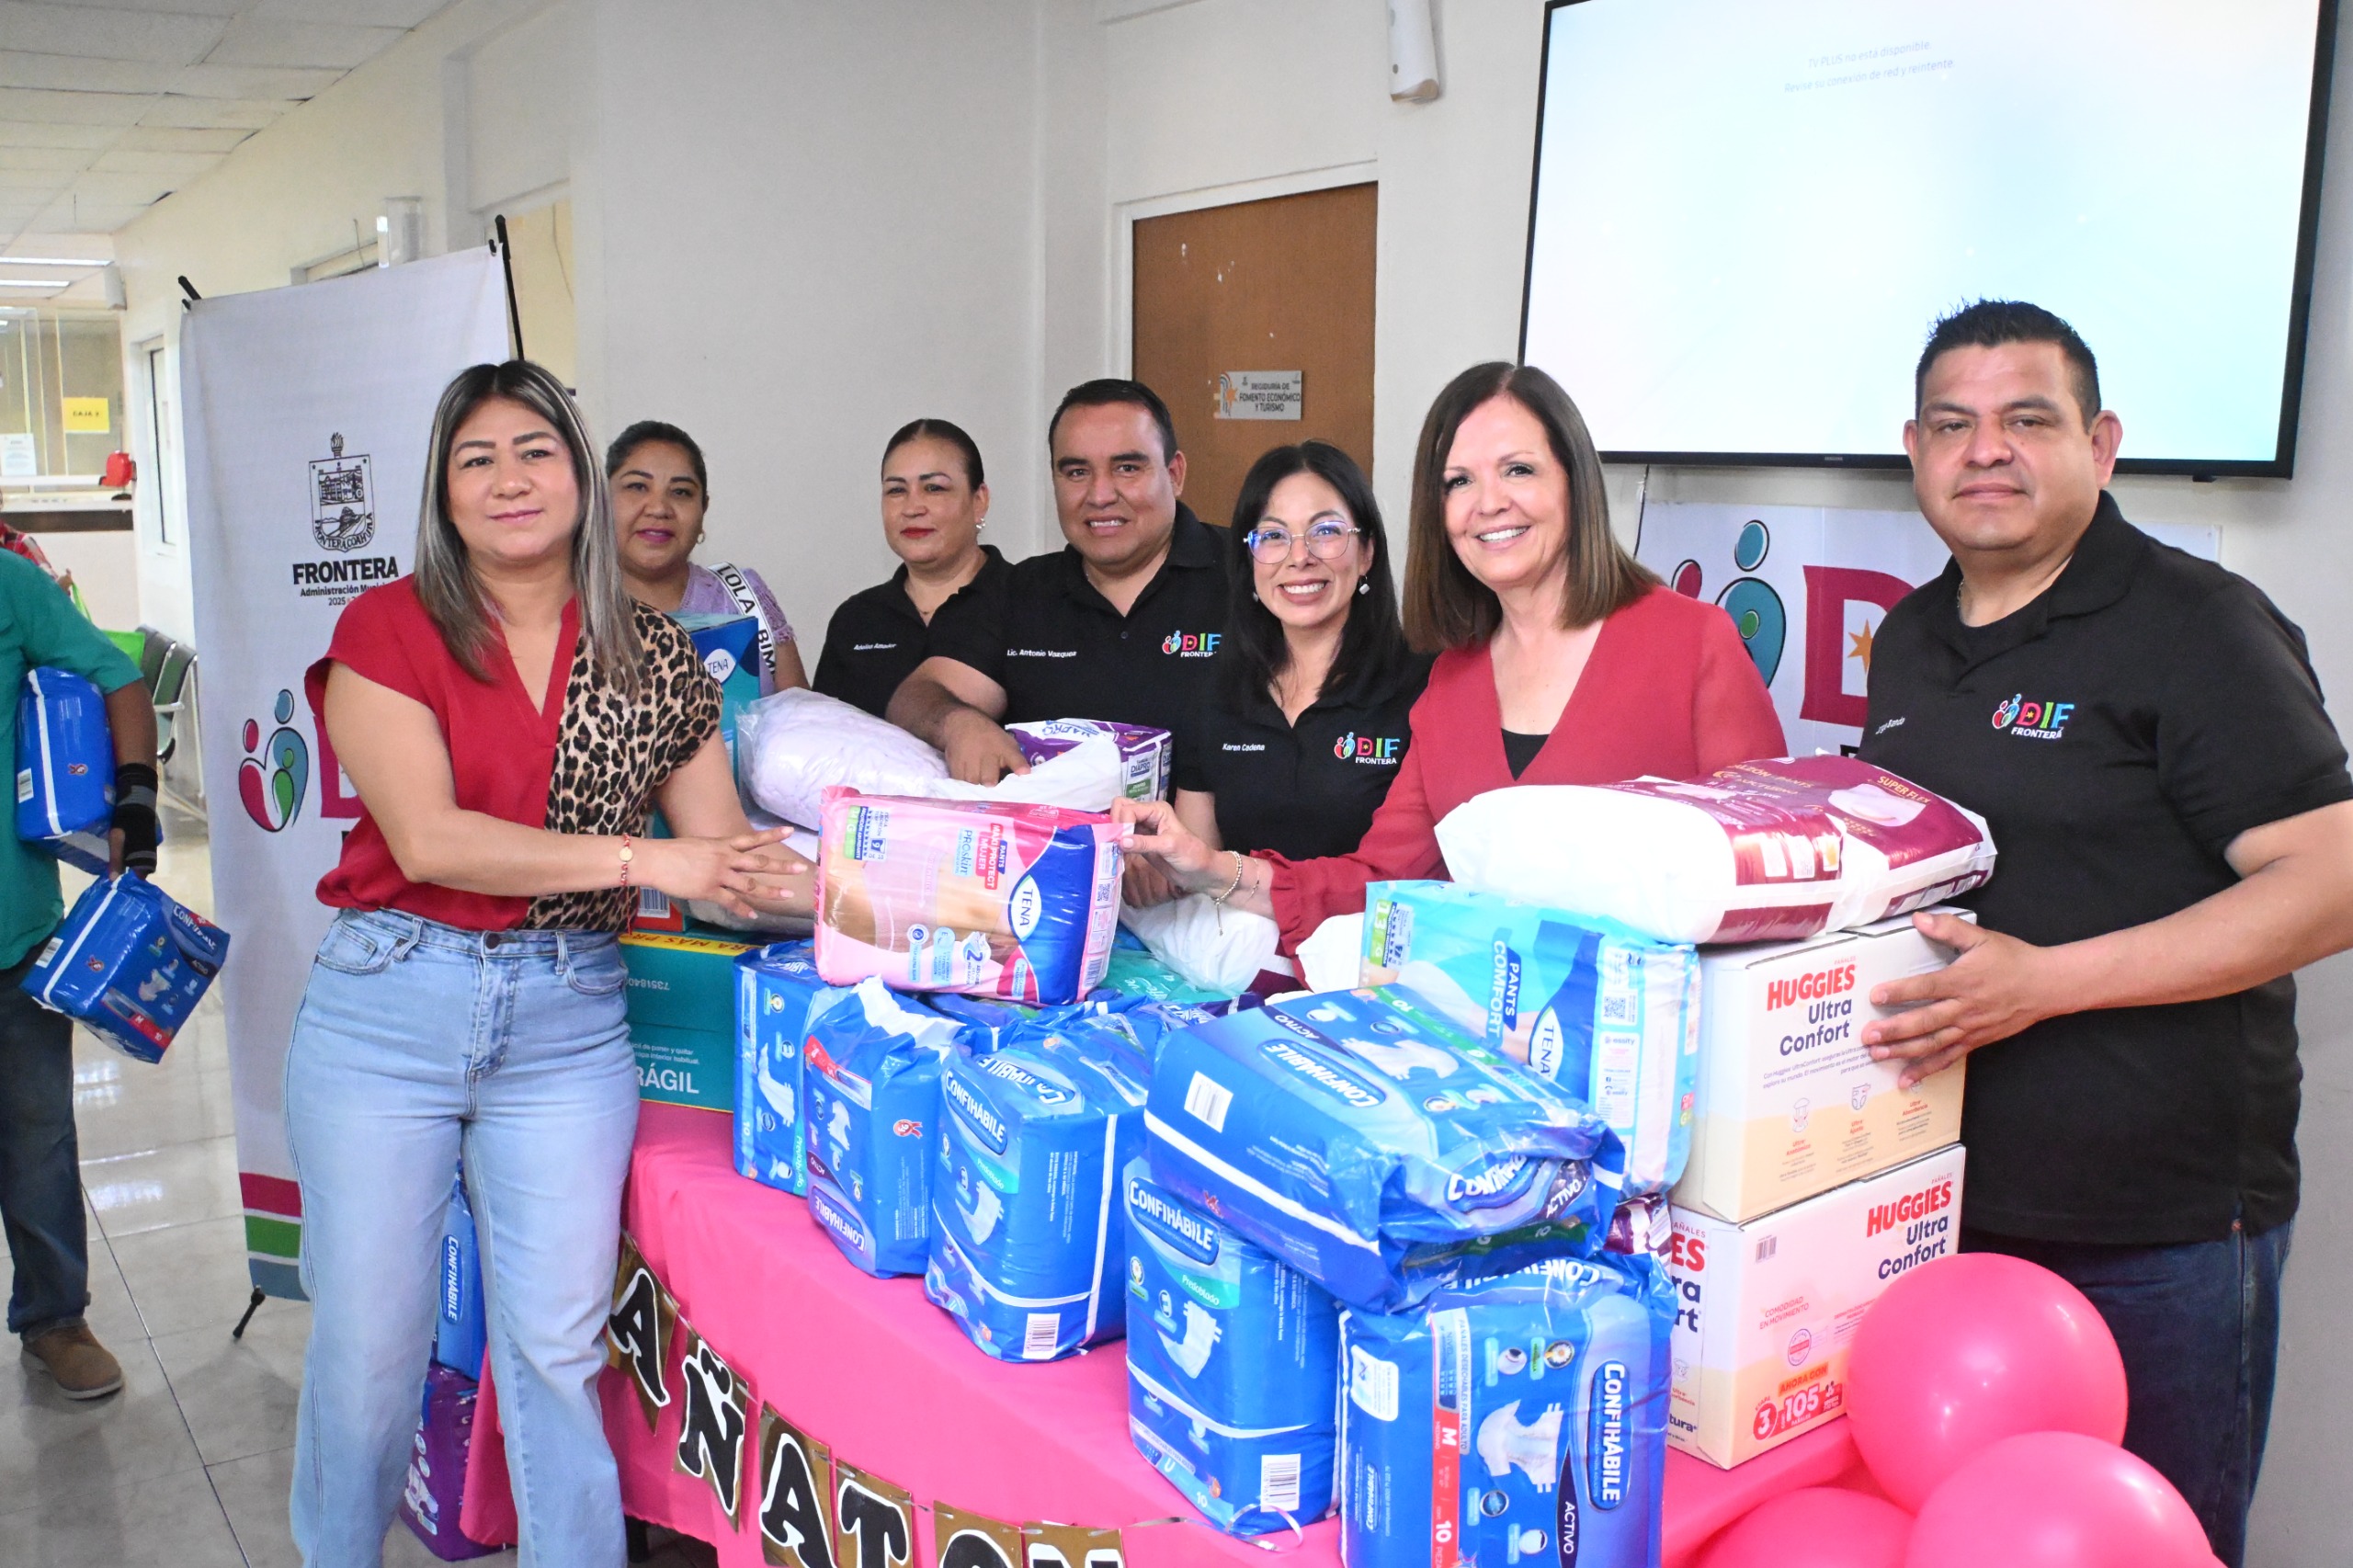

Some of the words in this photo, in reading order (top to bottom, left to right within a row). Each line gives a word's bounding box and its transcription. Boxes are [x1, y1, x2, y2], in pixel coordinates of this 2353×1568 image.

[1821, 54, 1843, 67] PLUS
[1845, 54, 1856, 63] no
[1785, 80, 1812, 93] Revise
[1814, 79, 1824, 89] su
[1870, 70, 1881, 80] de
[1883, 67, 1899, 79] red
[1239, 392, 1266, 402] FOMENTO
[1267, 391, 1301, 402] ECONÓMICO
[1255, 403, 1259, 412] Y
[1260, 403, 1285, 412] TURISMO
[292, 556, 399, 585] FRONTERA
[301, 585, 359, 597] Administración
[328, 597, 347, 607] 2025
[717, 565, 756, 614] LOLA
[1019, 649, 1046, 657] Antonio
[1181, 632, 1222, 652] DIF
[708, 658, 729, 674] TENA
[2016, 701, 2075, 729] DIF
[2011, 726, 2063, 739] FRONTERA
[1222, 743, 1241, 751] Karen
[1355, 756, 1397, 765] FRONTERA
[1357, 737, 1400, 758] DIF
[1876, 775, 1906, 796] SUPER
[1906, 789, 1930, 805] FLEX
[991, 825, 1001, 846] MAXI
[960, 830, 972, 874] PROskin
[978, 838, 988, 870] MUJER
[998, 845, 1006, 868] PANTS
[987, 846, 999, 888] PROTECT
[1019, 889, 1033, 926] TENA
[967, 949, 983, 961] 2
[1488, 940, 1506, 1038] COMFORT
[1505, 962, 1519, 1017] PANTS
[1767, 964, 1856, 1011] HUGGIES
[1392, 999, 1414, 1012] 10
[1808, 999, 1852, 1024] Ultra
[1274, 1015, 1320, 1040] ACTIVO
[1612, 1037, 1635, 1045] essity
[1779, 1019, 1849, 1056] Confort
[1540, 1025, 1554, 1075] TENA
[635, 1062, 700, 1094] RÁGIL
[743, 1120, 750, 1137] 10
[811, 1156, 825, 1176] ACTIVO
[977, 1157, 1005, 1190] Predoblado
[1931, 1172, 1953, 1184] PAÑALES
[1546, 1178, 1582, 1219] ACTIVO
[1867, 1181, 1952, 1237] HUGGIES
[1130, 1181, 1214, 1251] CONFIHÁBILE
[1535, 1225, 1552, 1238] 10
[1905, 1215, 1949, 1245] Ultra
[1878, 1236, 1947, 1279] Confort
[1182, 1274, 1220, 1306] Predoblado
[1759, 1319, 1769, 1329] EN
[1769, 1302, 1810, 1326] MOVIMIENTO
[1765, 1296, 1804, 1318] COMODIDAD
[1779, 1374, 1808, 1393] AHORA
[1809, 1365, 1827, 1380] CON
[1784, 1383, 1820, 1422] 105
[1602, 1363, 1626, 1502] CONFIHÁBILE
[1757, 1408, 1771, 1435] 3
[1442, 1427, 1457, 1447] M
[1165, 1457, 1176, 1472] U
[1196, 1492, 1208, 1507] 10
[1436, 1521, 1452, 1543] 10
[1563, 1501, 1575, 1554] ACTIVO
